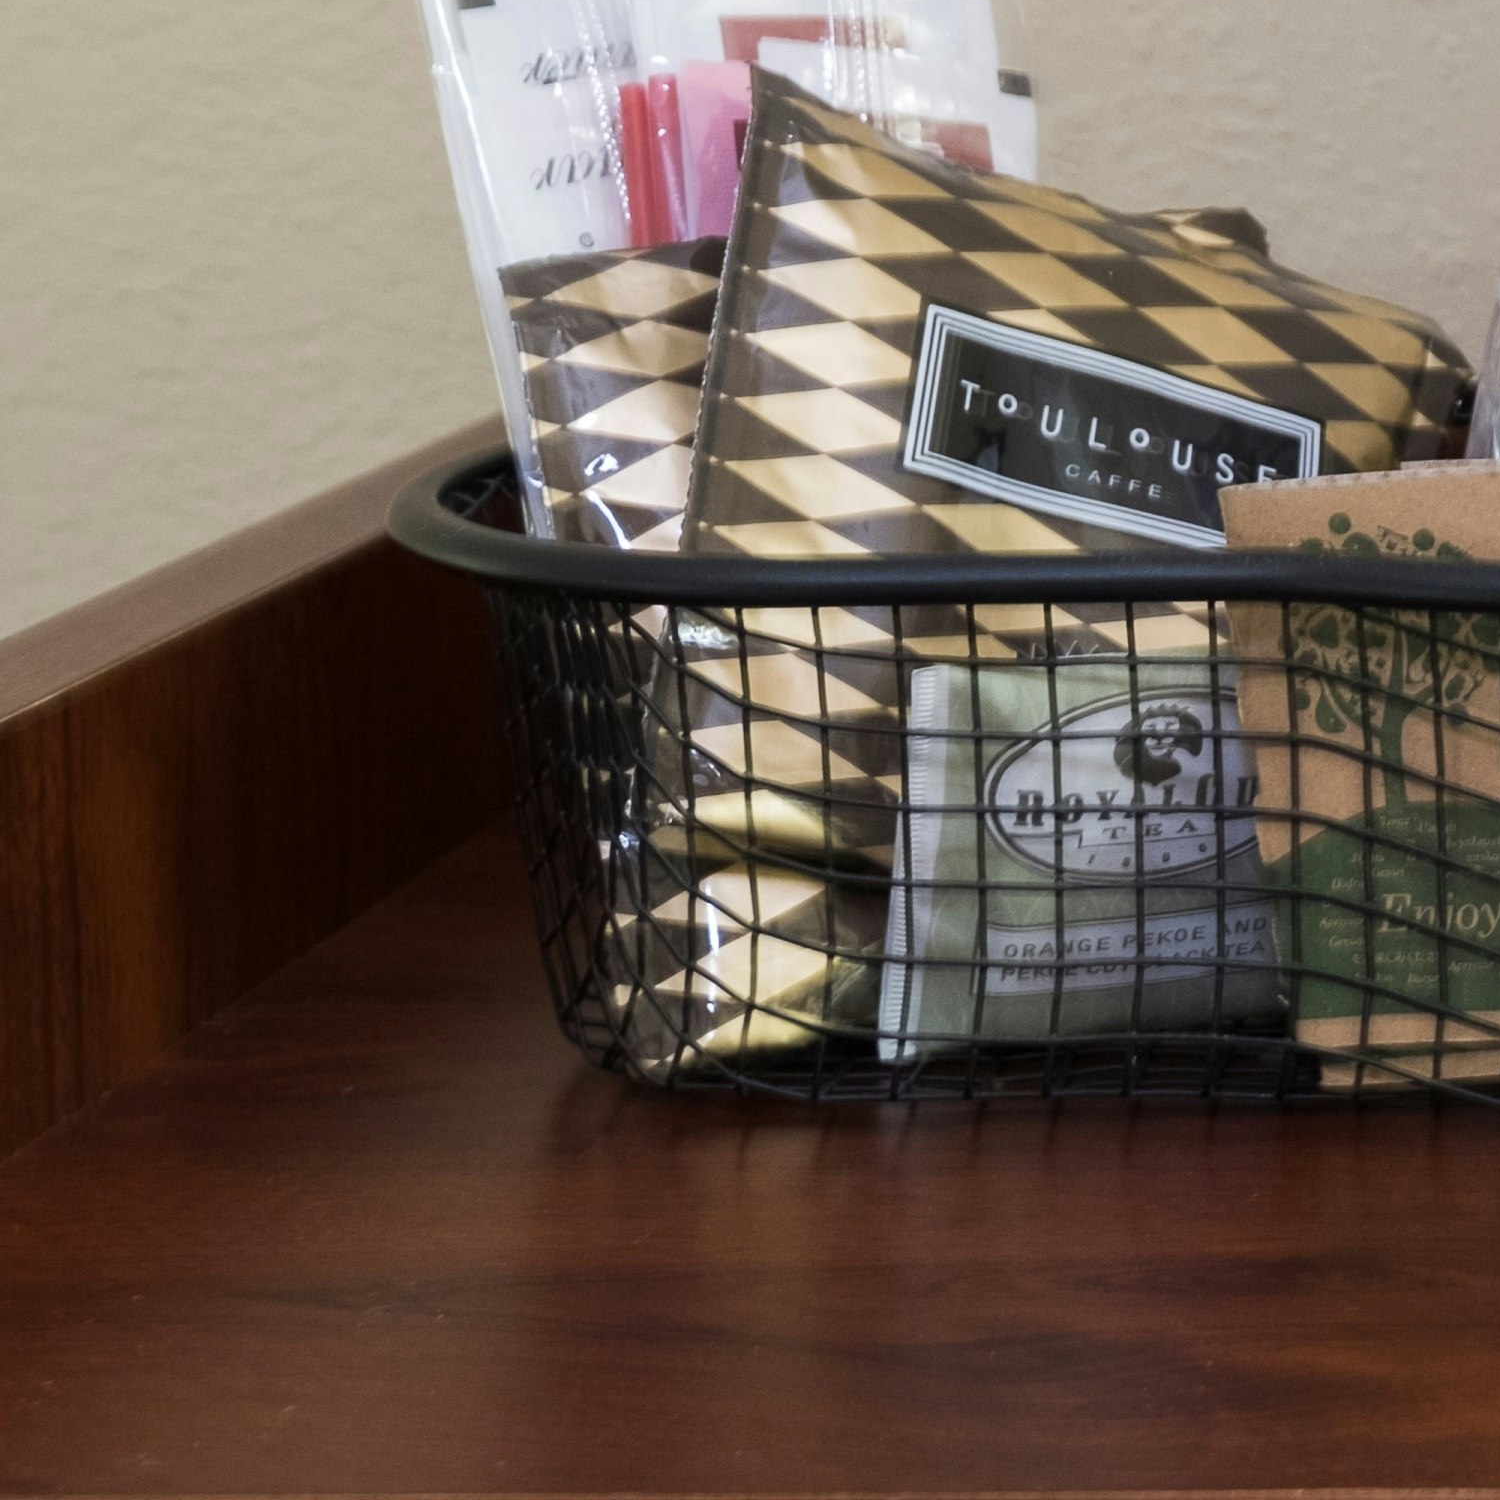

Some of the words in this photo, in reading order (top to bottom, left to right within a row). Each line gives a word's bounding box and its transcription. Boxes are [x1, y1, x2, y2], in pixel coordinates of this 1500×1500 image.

[960, 379, 1278, 485] TOULOUSE
[1064, 463, 1163, 499] CAFFE
[1102, 819, 1198, 840] TEA
[1004, 936, 1112, 959] ORANGE
[1122, 925, 1207, 949] PEKOE
[1143, 945, 1216, 969] LACK
